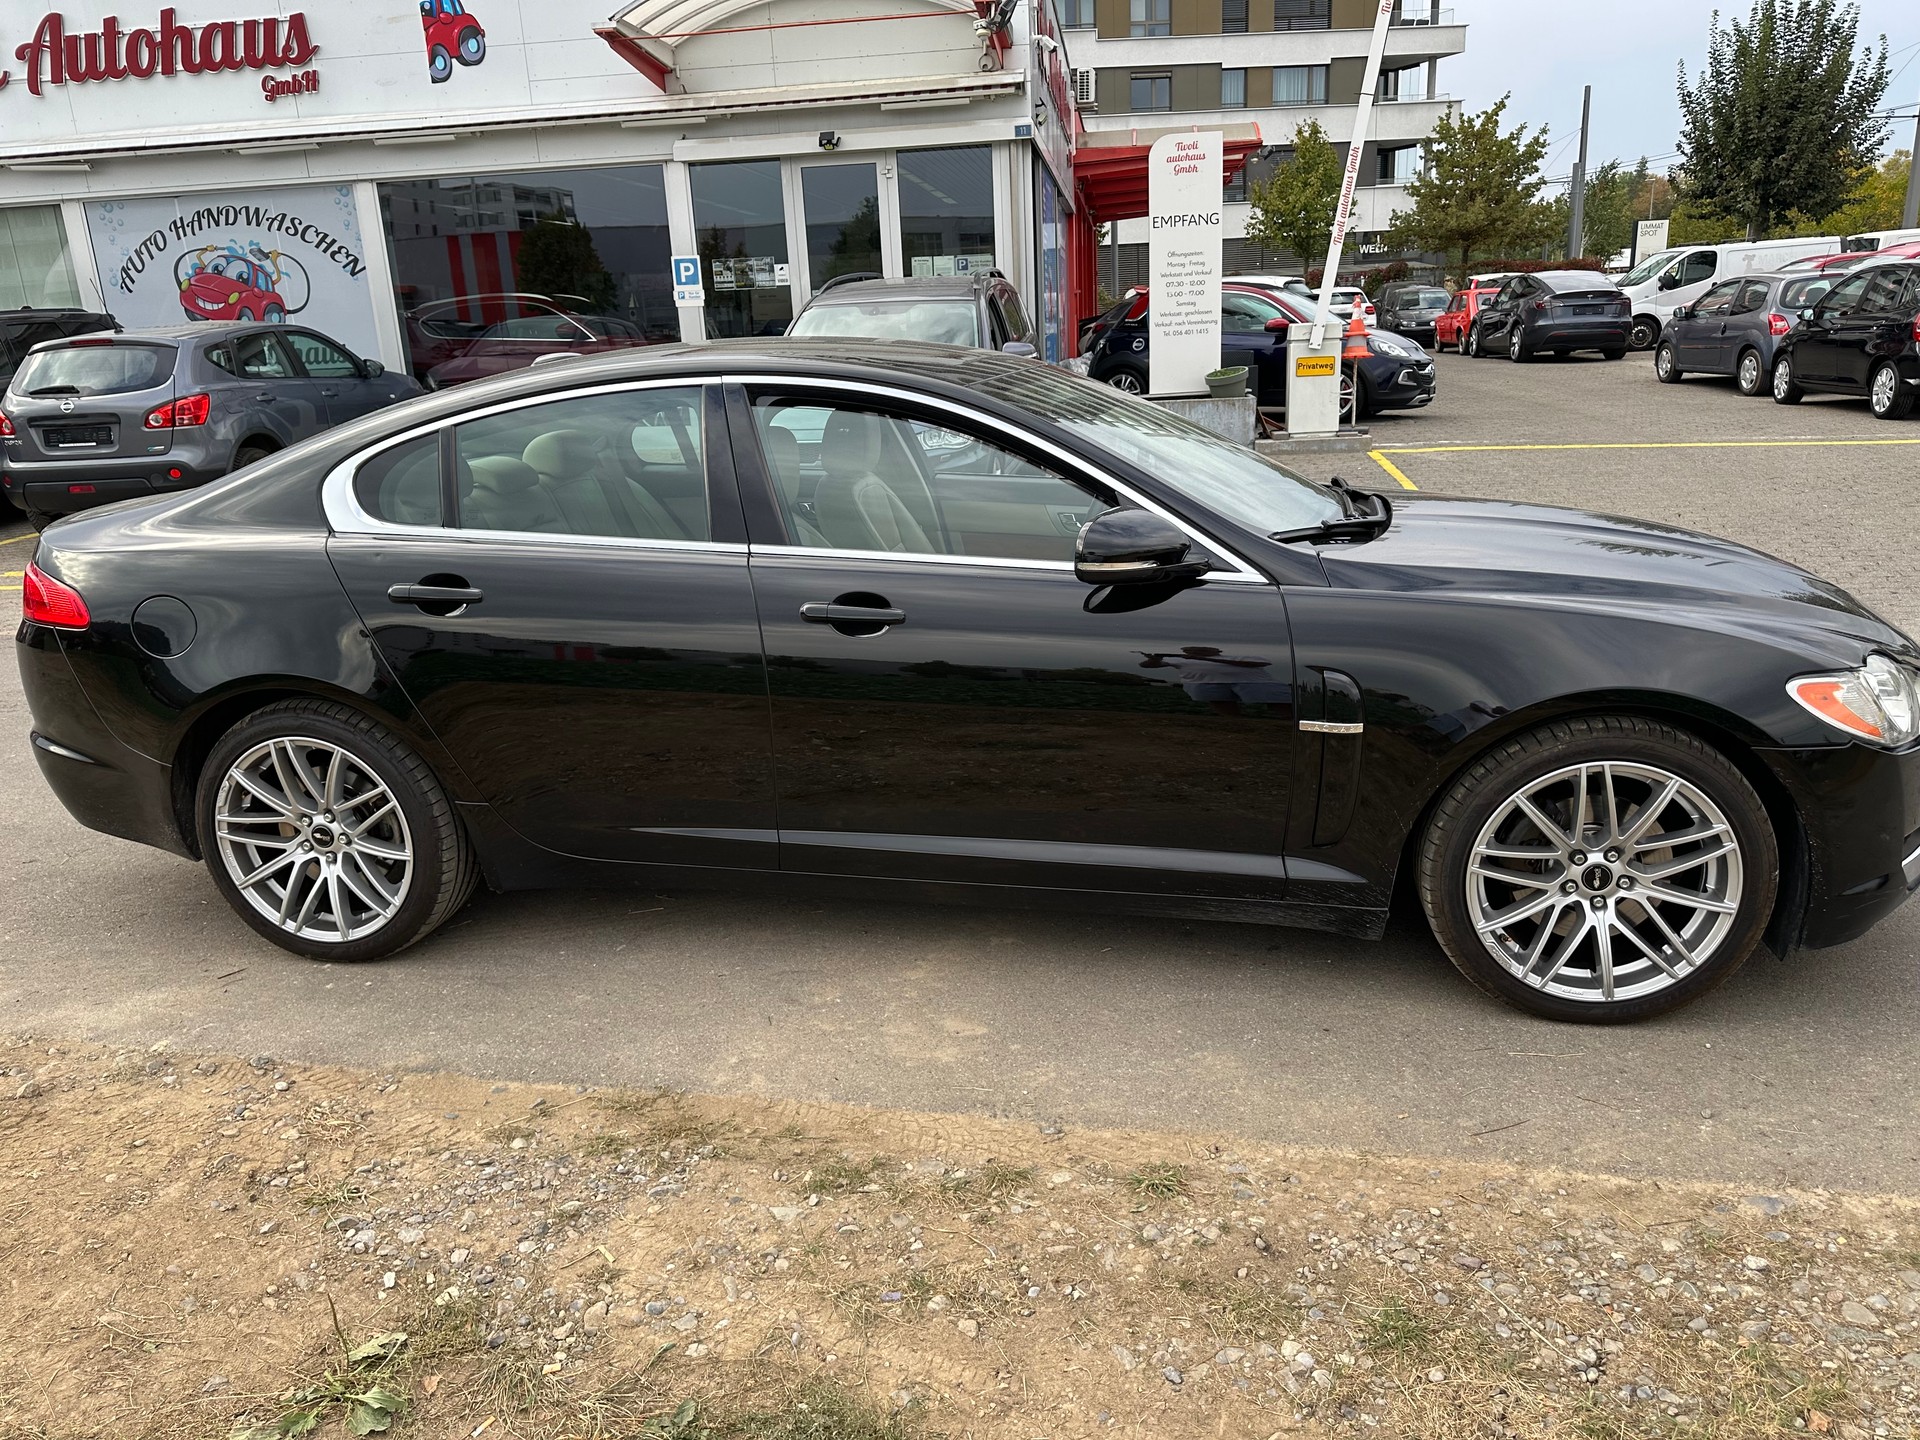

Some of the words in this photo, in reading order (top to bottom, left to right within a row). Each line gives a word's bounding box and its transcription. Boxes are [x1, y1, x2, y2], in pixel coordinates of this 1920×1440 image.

[14, 6, 321, 98] Autohaus
[260, 69, 320, 103] GmbH
[1019, 126, 1027, 135] 11
[1174, 140, 1199, 152] Tivoli
[1166, 152, 1206, 163] autohaus
[1346, 145, 1360, 174] Gmbh
[1173, 163, 1198, 176] Gmbh
[1340, 175, 1354, 219] autohaus
[1152, 212, 1220, 229] EMPFANG
[1332, 220, 1346, 246] Tivoli
[119, 229, 168, 294] AUTO
[168, 204, 367, 278] HANDWASCHEN
[1165, 280, 1185, 288] 07.30
[1297, 362, 1334, 371] Privatweg
